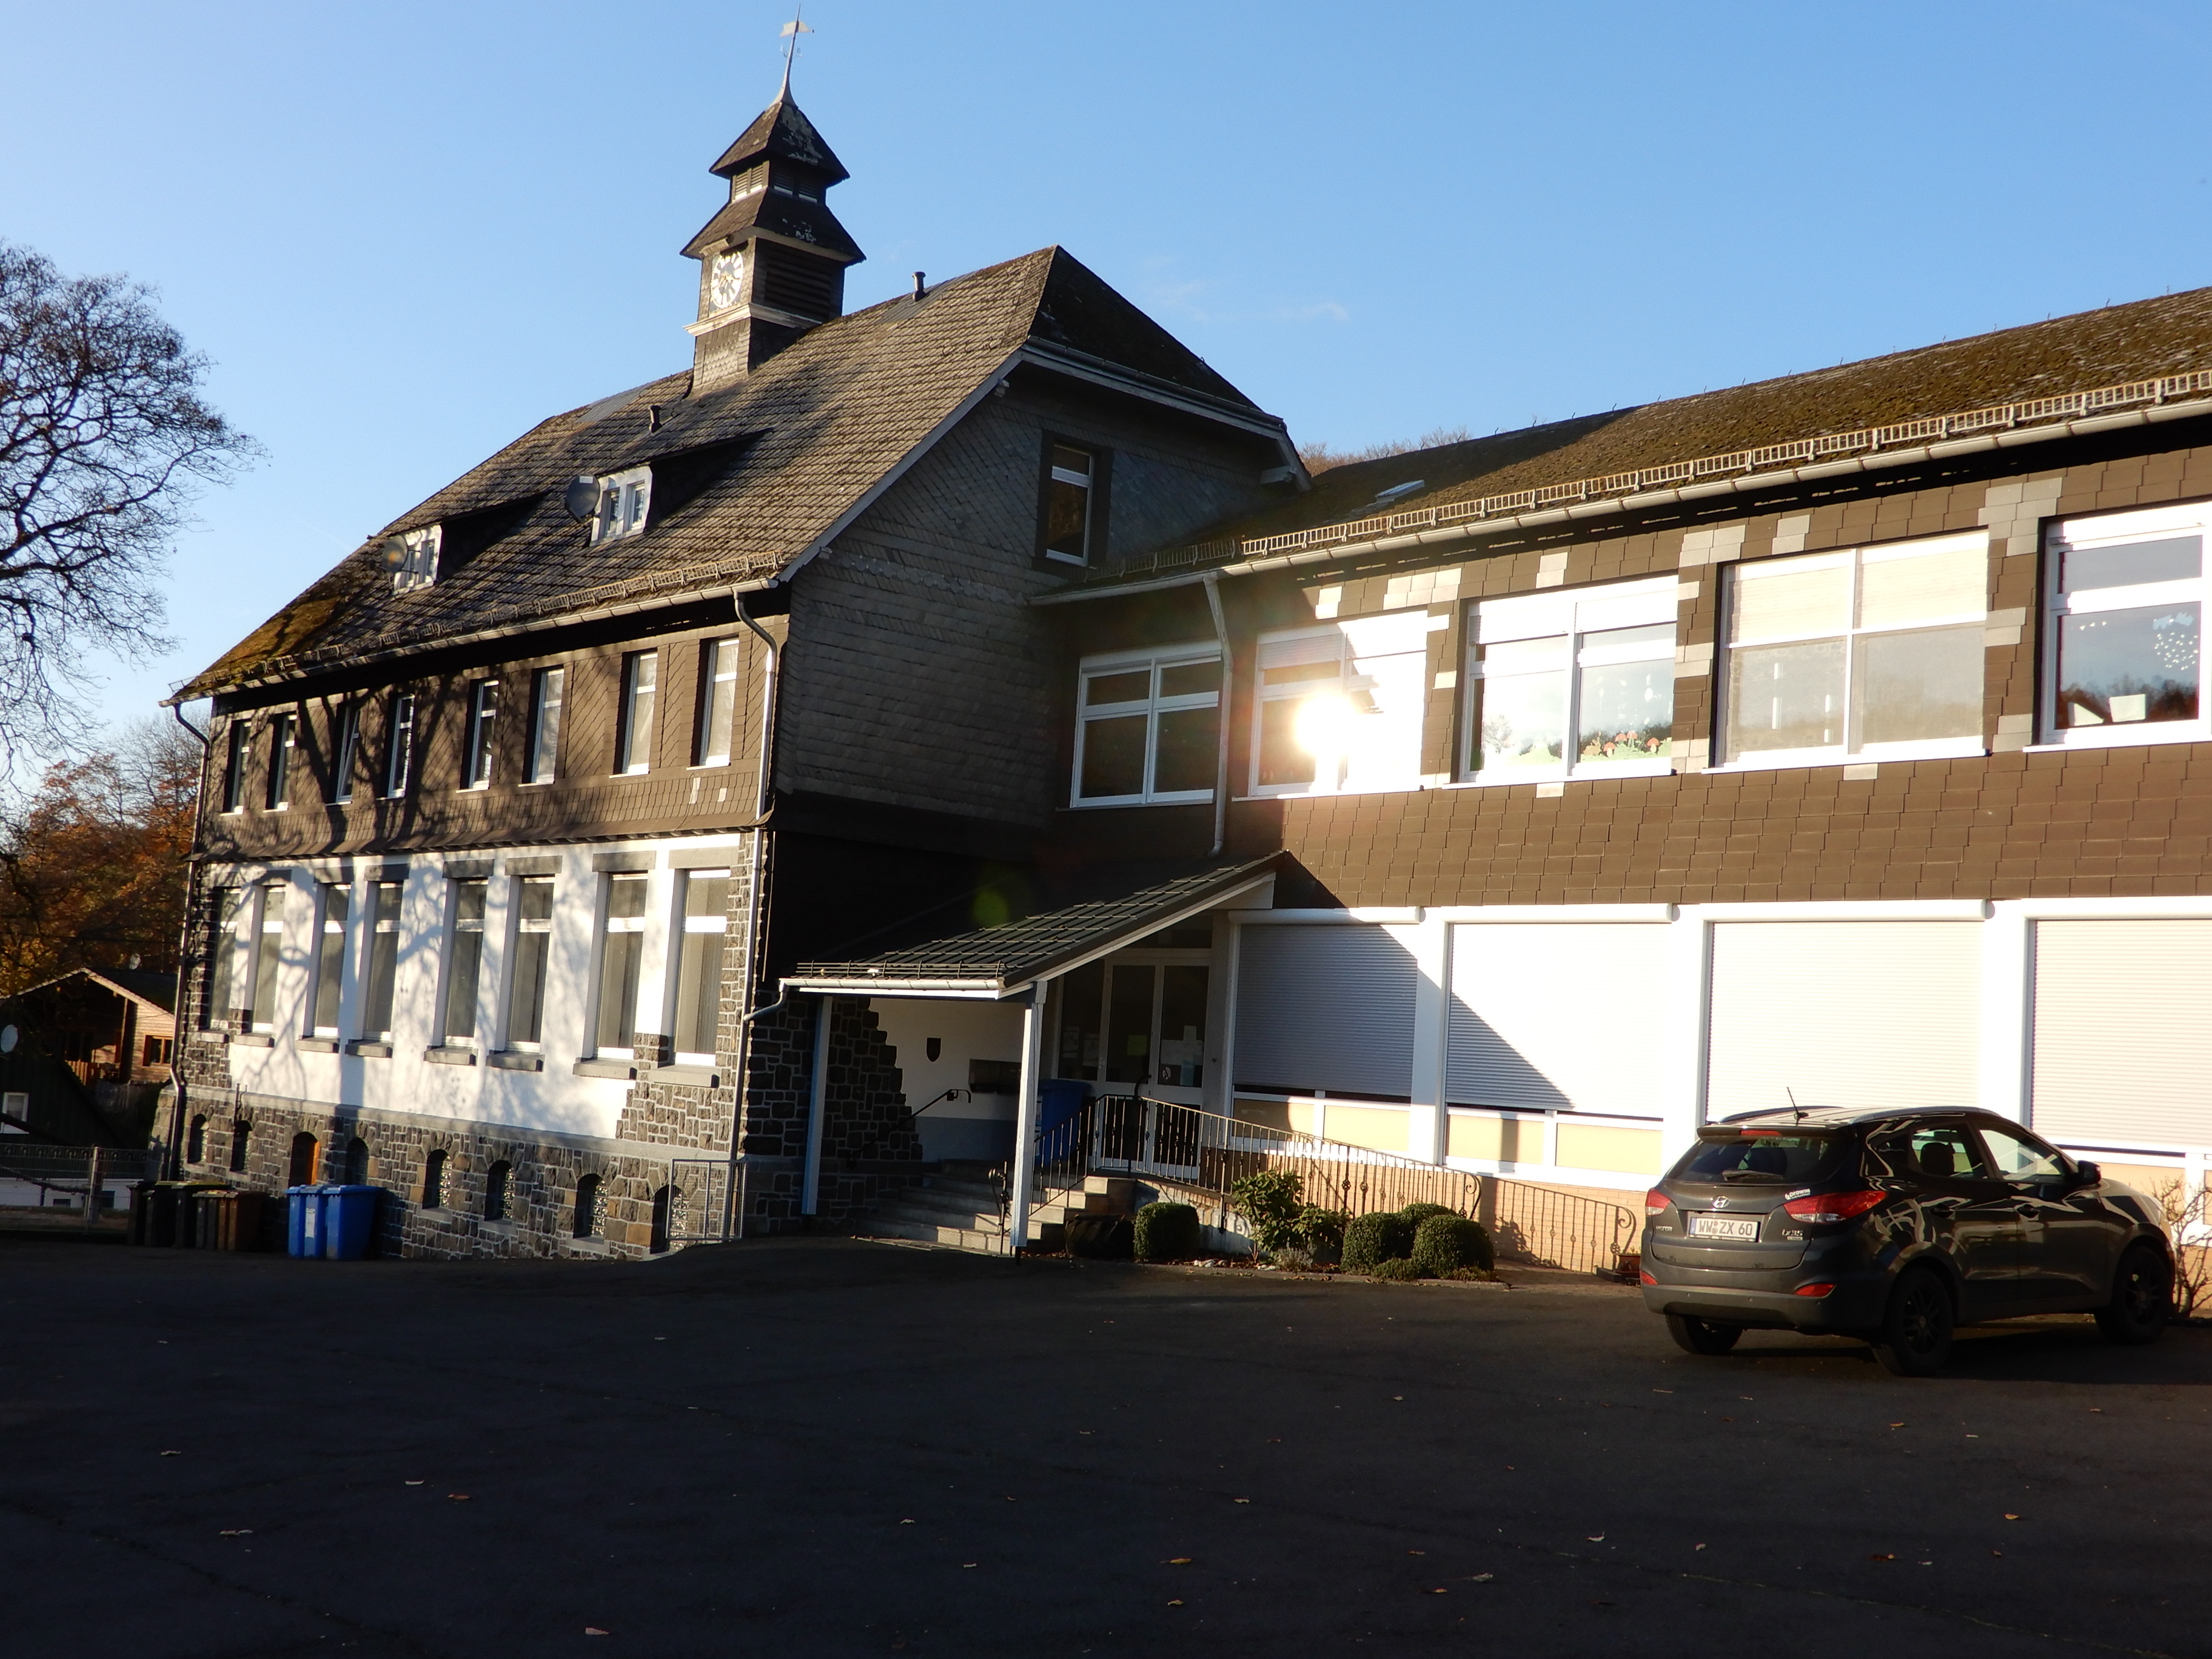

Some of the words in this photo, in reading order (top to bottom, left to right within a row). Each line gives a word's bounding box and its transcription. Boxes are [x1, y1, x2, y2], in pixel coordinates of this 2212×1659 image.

[1699, 1220, 1714, 1233] WW
[1718, 1221, 1735, 1235] ZX
[1738, 1222, 1753, 1236] 60
